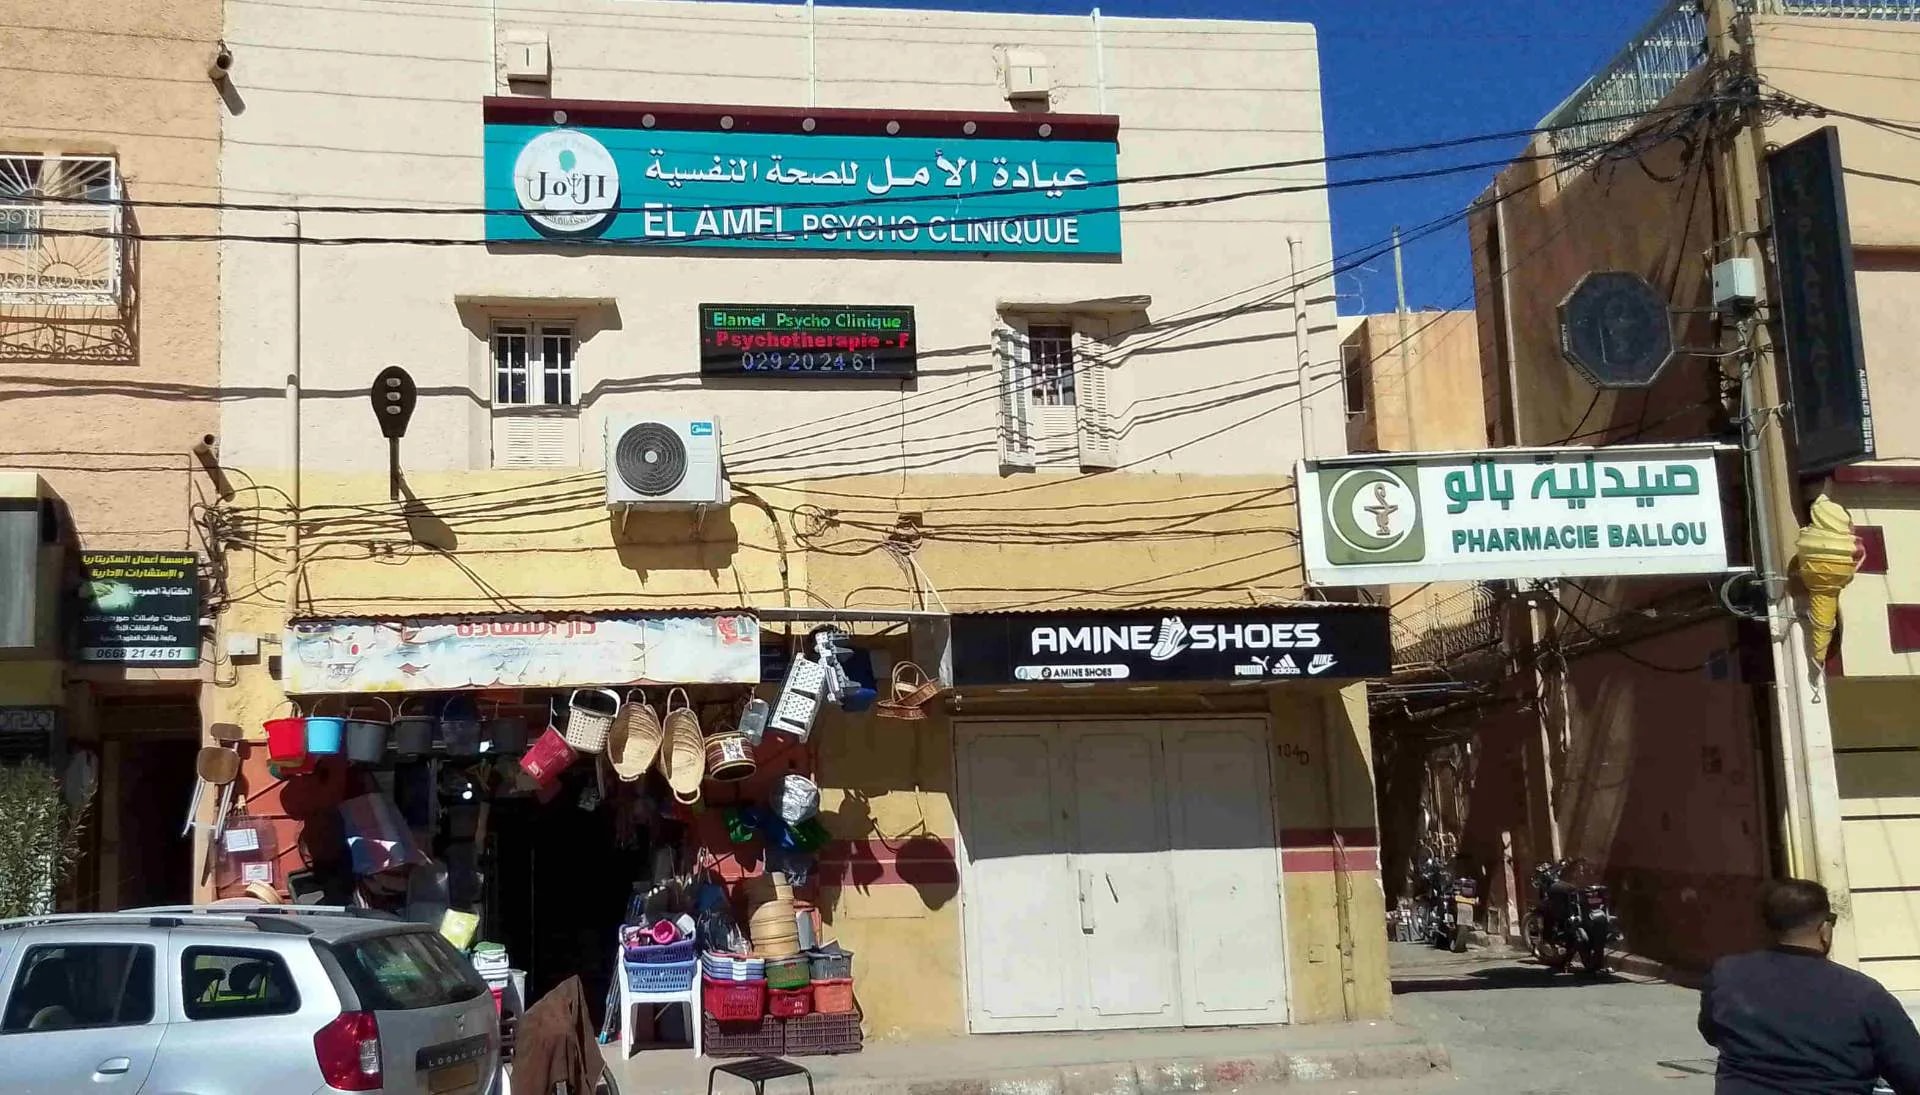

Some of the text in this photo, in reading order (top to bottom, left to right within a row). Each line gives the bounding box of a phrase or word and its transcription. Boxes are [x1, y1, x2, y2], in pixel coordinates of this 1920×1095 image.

[645, 148, 758, 188] النفسية
[765, 155, 859, 186] للصحة
[992, 156, 1089, 197] عيادة
[644, 202, 686, 237] EL
[693, 204, 796, 241] AMEL
[802, 213, 919, 241] PSYCHO
[713, 312, 902, 331] Elamel Psycho Clinique
[716, 331, 880, 351] Psychotherapie
[741, 352, 877, 371] 029 20 24 61
[1445, 457, 1515, 514] بالو
[1452, 521, 1707, 553] PHARMACIE BALLOU
[96, 648, 181, 658] 0668 21 41 61
[1031, 623, 1321, 656] AMINE SHOES
[1054, 667, 1112, 678] AMINE SHOES
[1312, 654, 1334, 666] NIKE
